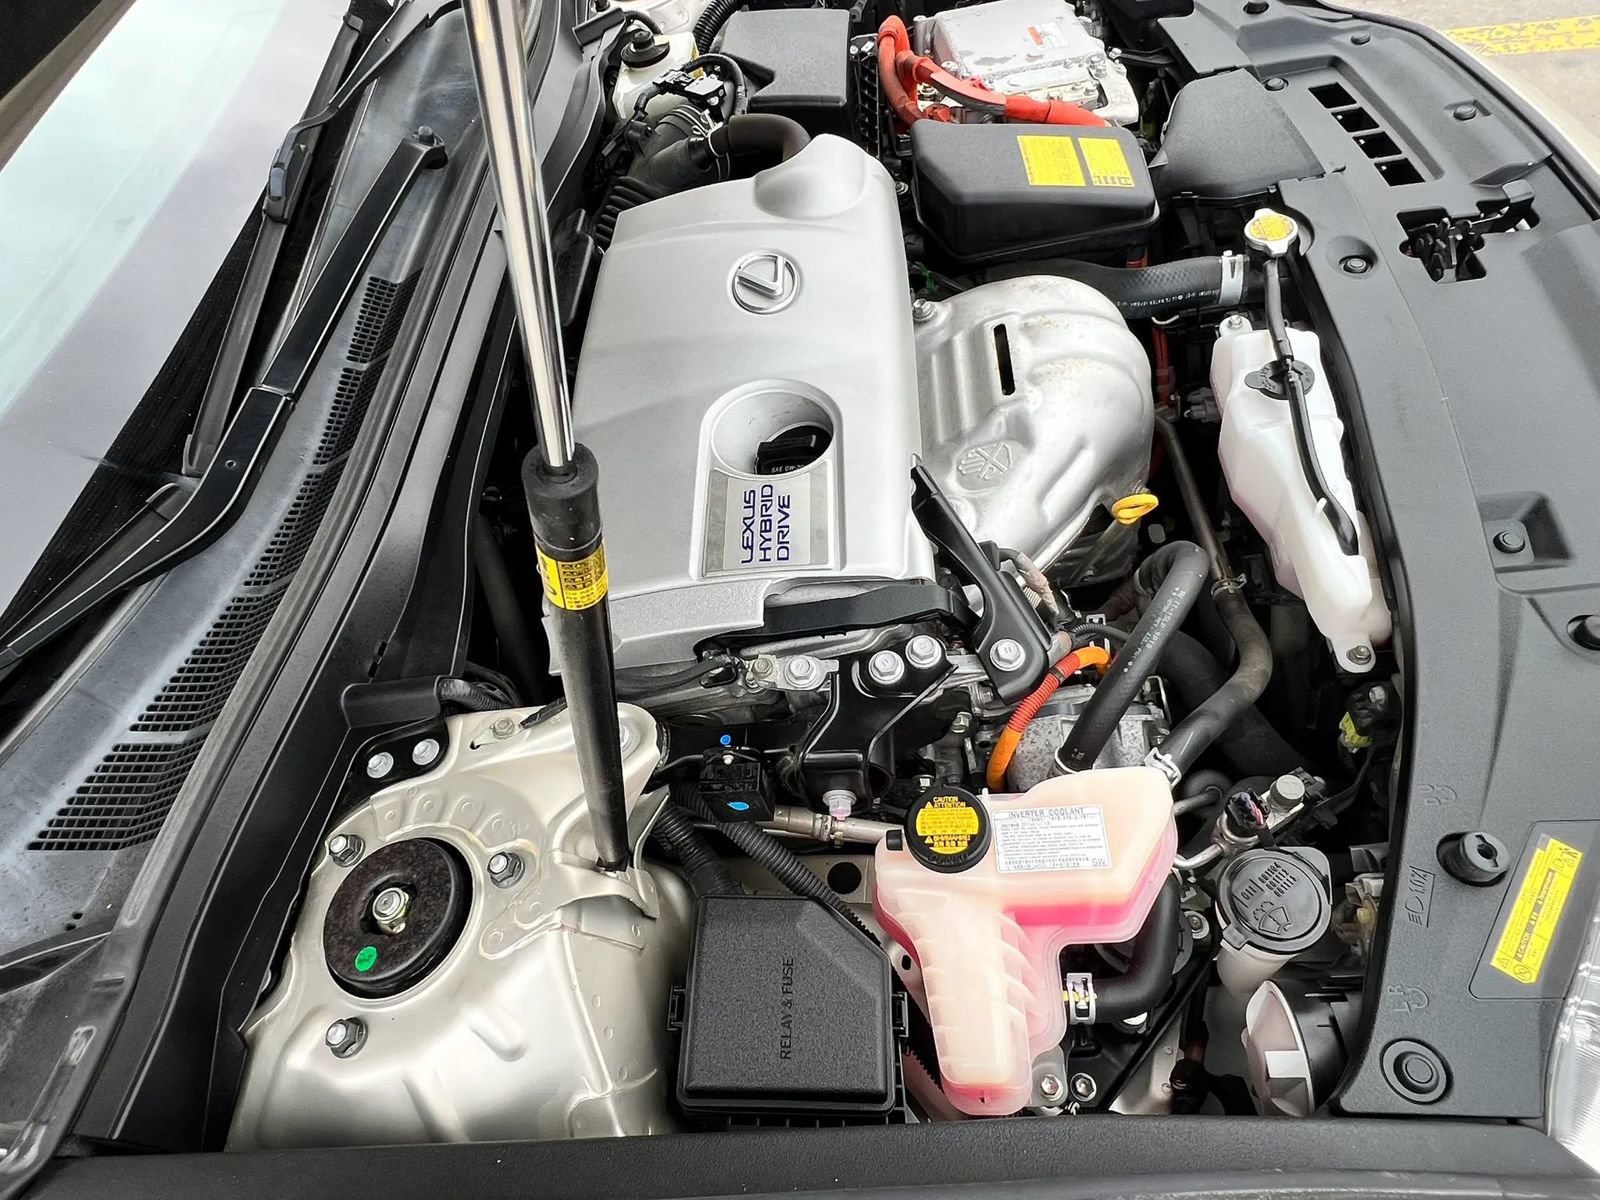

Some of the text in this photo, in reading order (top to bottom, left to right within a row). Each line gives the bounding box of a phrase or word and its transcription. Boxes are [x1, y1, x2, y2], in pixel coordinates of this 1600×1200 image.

[741, 489, 756, 564] LEXUS
[759, 484, 774, 562] HYBRID
[776, 494, 791, 561] DRIVE
[1009, 811, 1045, 819] INVERTER
[1048, 807, 1085, 817] COOLANT
[780, 957, 794, 1060] RELAY & FUSE
